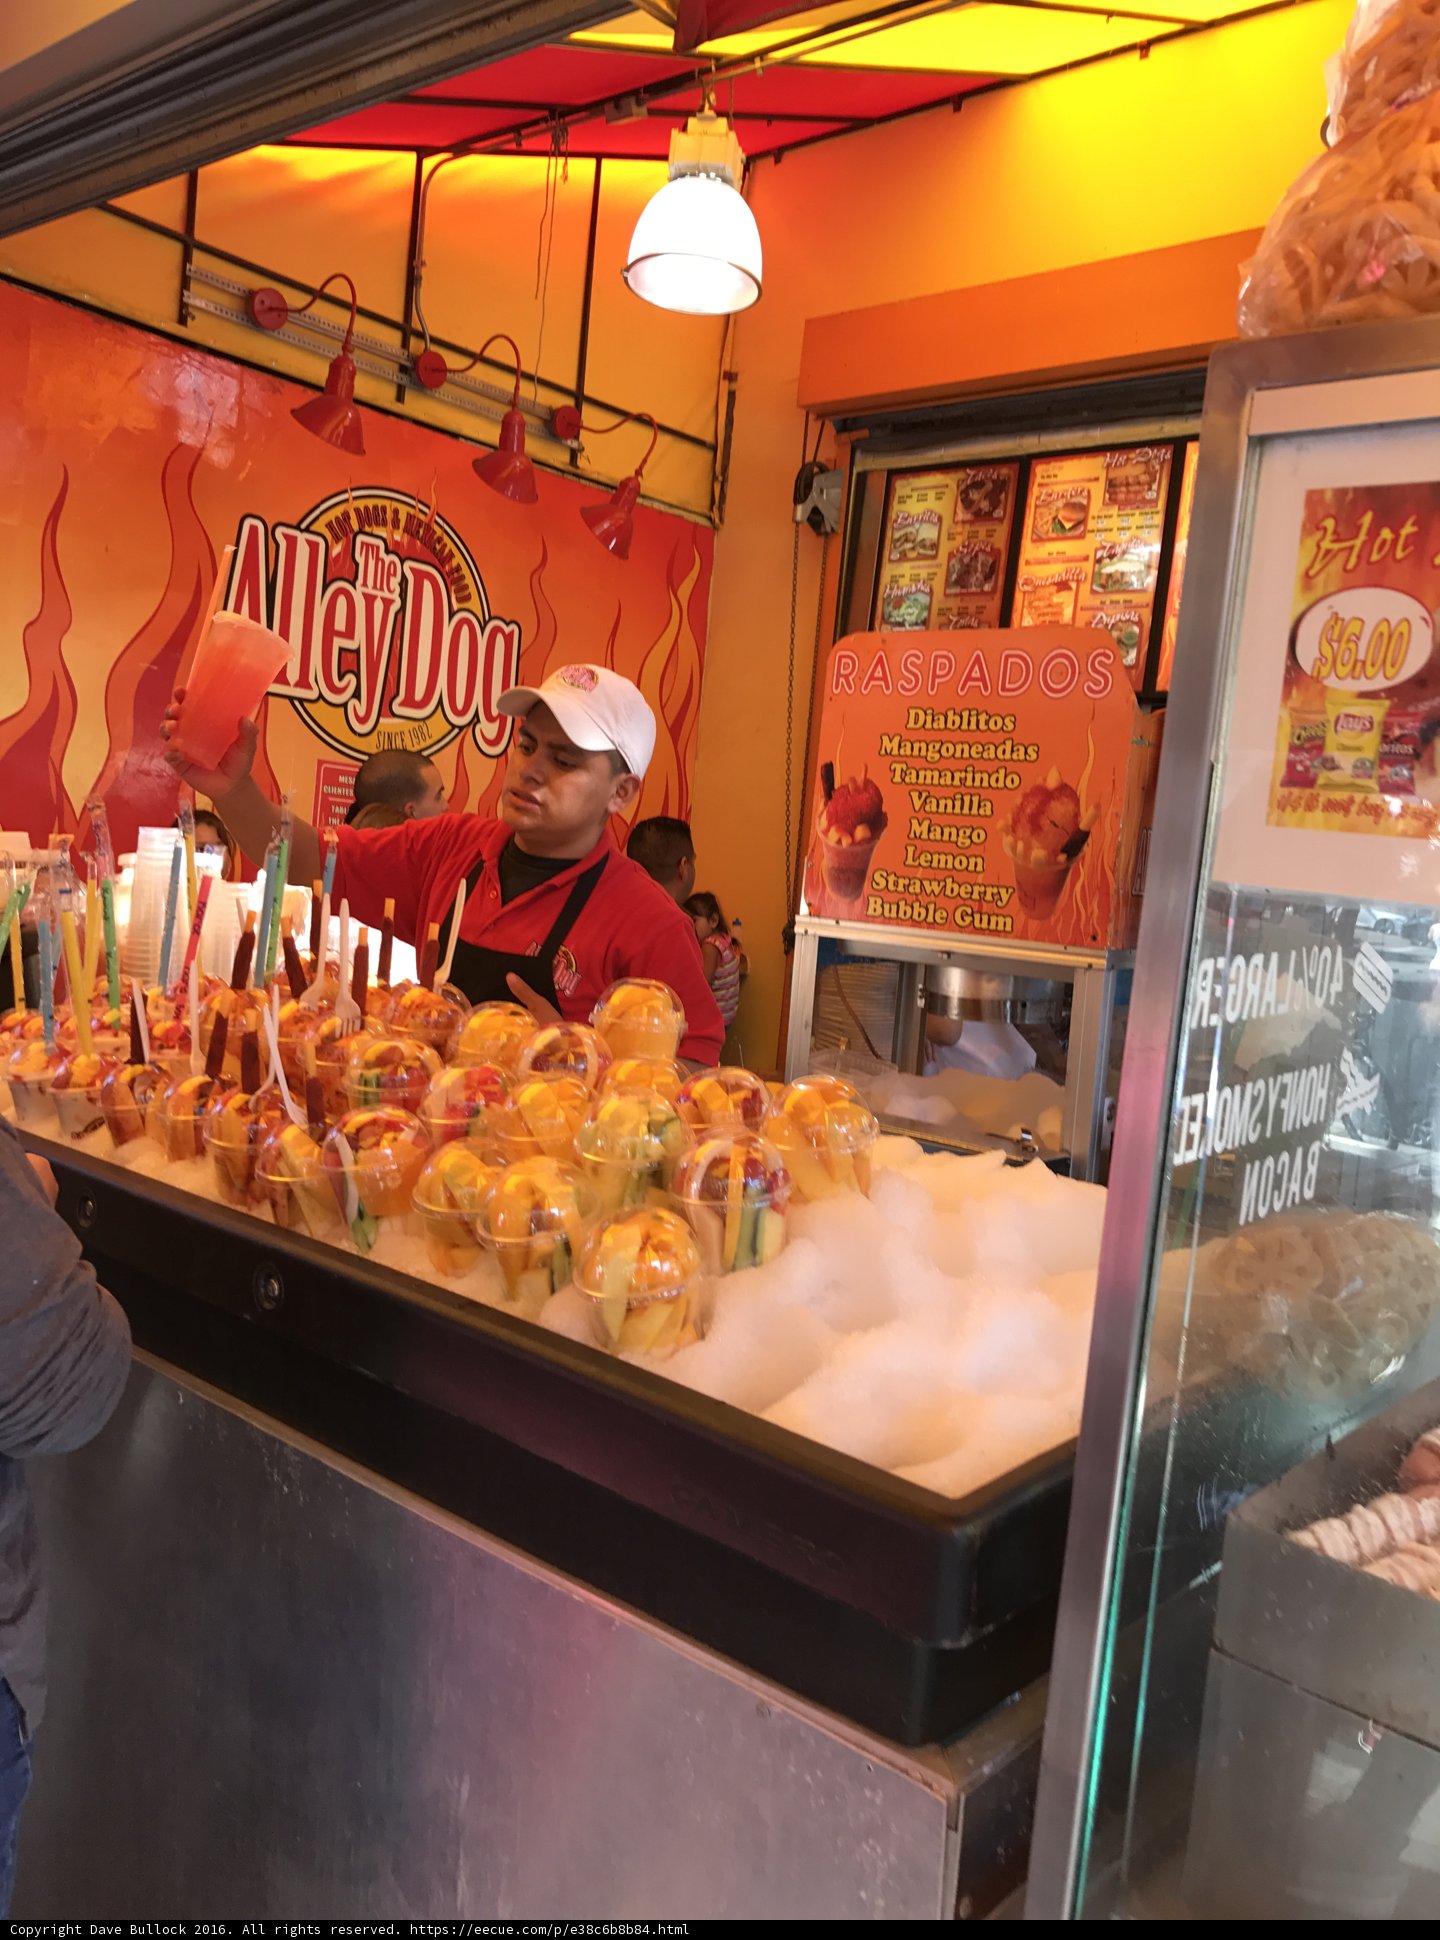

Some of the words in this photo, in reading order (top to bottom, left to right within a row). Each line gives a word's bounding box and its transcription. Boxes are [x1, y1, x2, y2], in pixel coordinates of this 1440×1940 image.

[325, 510, 354, 544] HOT
[353, 504, 388, 533] DOGS
[391, 507, 401, 530] &
[402, 511, 457, 569] MEXICAN
[449, 562, 472, 604] FOOD
[1306, 509, 1418, 578] Hot
[357, 536, 400, 595] The
[225, 517, 401, 735] Alley
[391, 558, 520, 757] Dog
[1312, 611, 1411, 683] $6.00
[832, 648, 1114, 698] RASPADOS
[376, 730, 408, 751] SINCE
[408, 719, 433, 748] 1982
[905, 706, 1016, 732] Diablitos
[879, 734, 1039, 764] Mangoneadas
[889, 763, 1021, 790] Tamarindo
[331, 804, 349, 815] TABL
[909, 789, 993, 816] Vanilla
[908, 817, 987, 848] Mango
[904, 845, 985, 872] Lemon
[872, 869, 1015, 907] Strawberry
[866, 896, 948, 924] Bubble
[953, 906, 1013, 933] Gum
